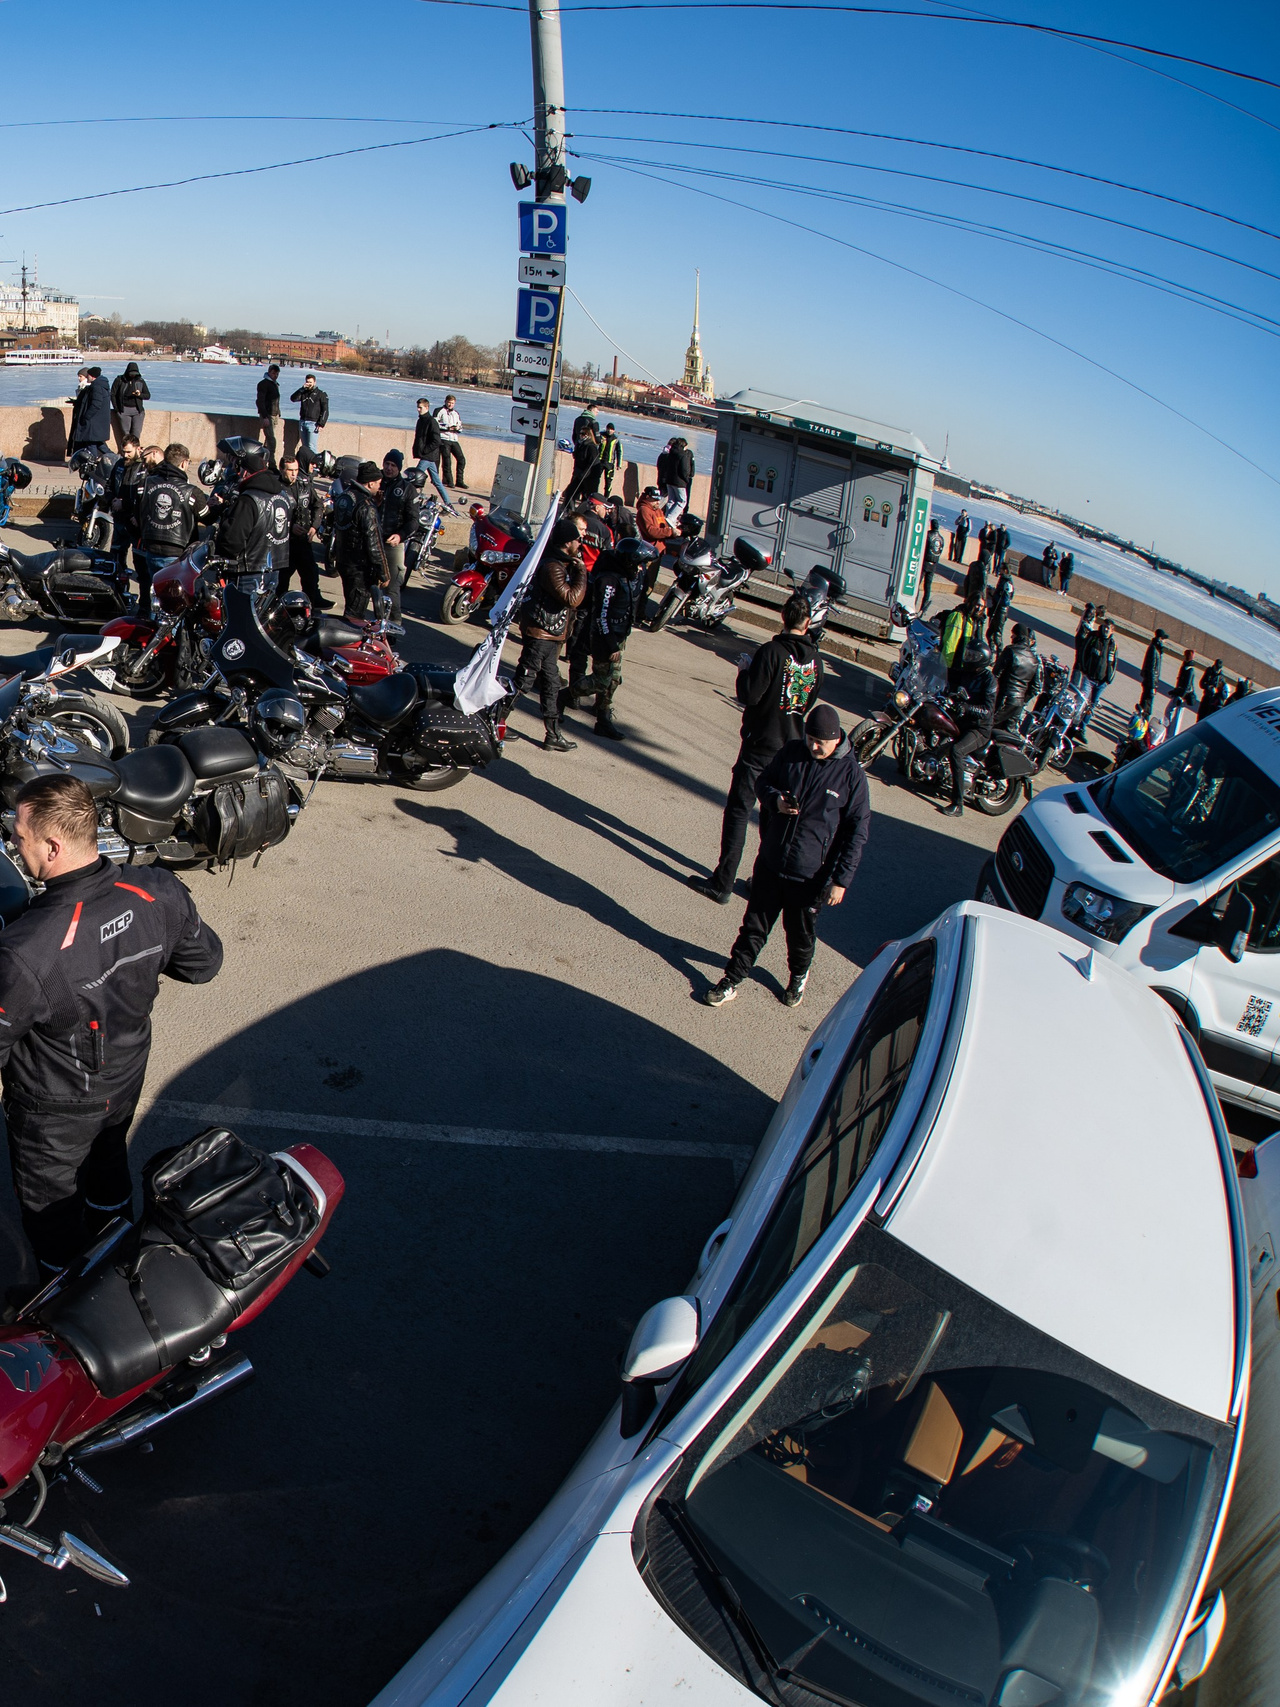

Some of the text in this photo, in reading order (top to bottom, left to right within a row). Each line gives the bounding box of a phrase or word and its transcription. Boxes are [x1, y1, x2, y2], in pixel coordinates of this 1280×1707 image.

[533, 209, 558, 247] P
[529, 295, 555, 335] P
[809, 423, 841, 437] ТУАЛЕТ
[907, 509, 924, 584] TOILET
[600, 585, 613, 635] HOOLIGANS
[102, 912, 132, 940] MCP
